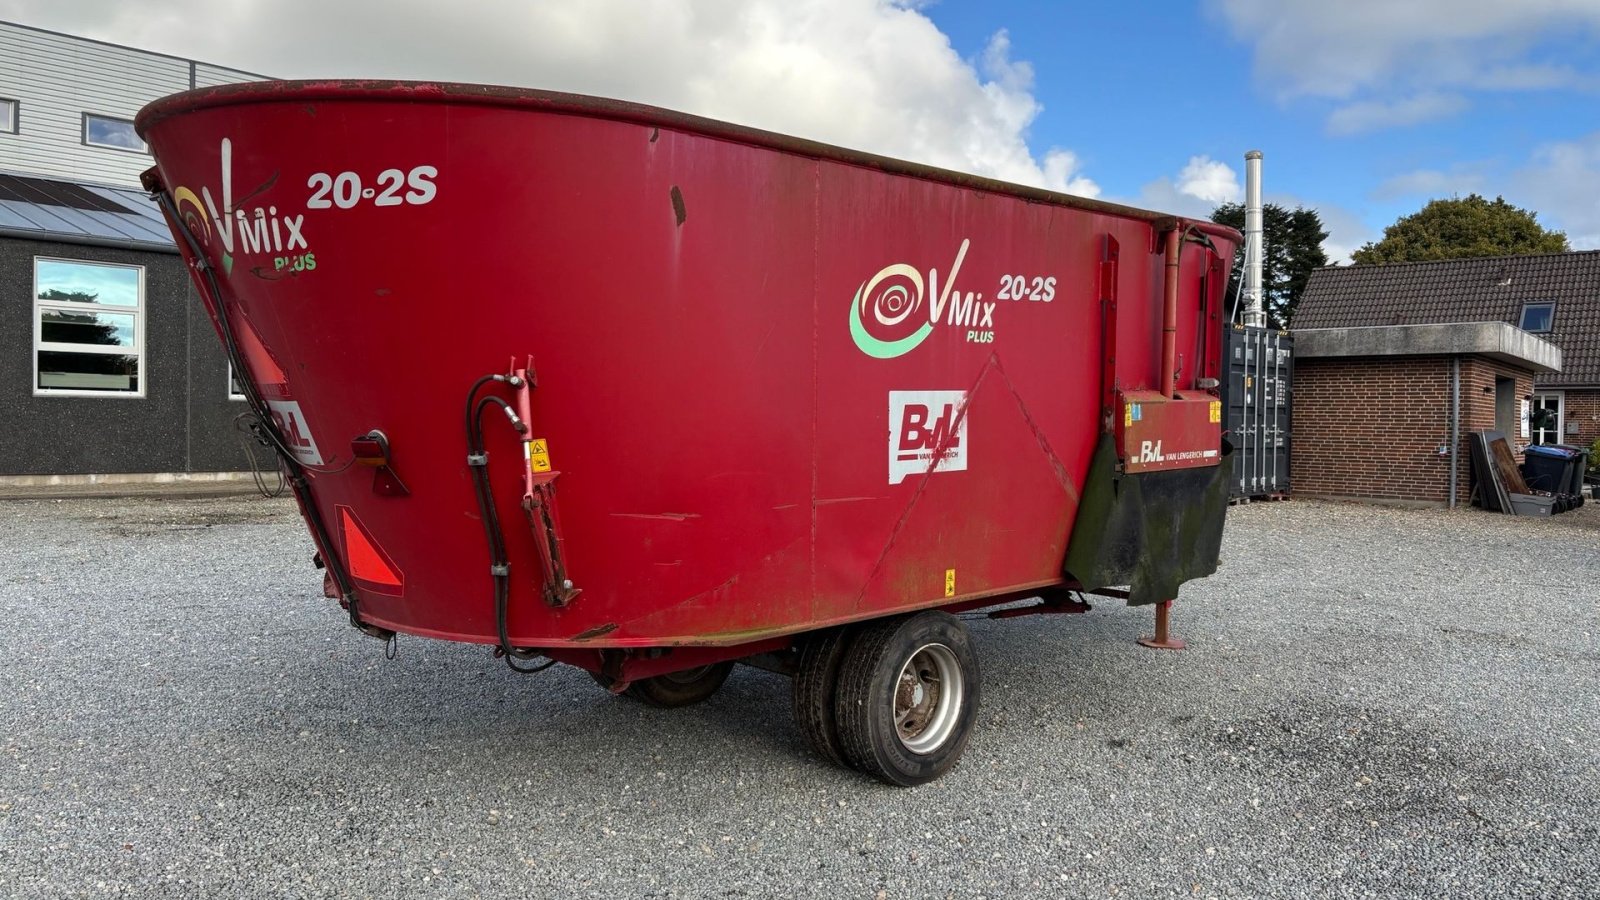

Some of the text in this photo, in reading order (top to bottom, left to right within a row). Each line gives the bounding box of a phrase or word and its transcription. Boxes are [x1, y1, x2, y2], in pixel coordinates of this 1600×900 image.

[306, 165, 438, 210] 20-2S
[997, 274, 1057, 303] 20-2S
[966, 331, 994, 344] PLUS
[1166, 453, 1177, 461] VAN
